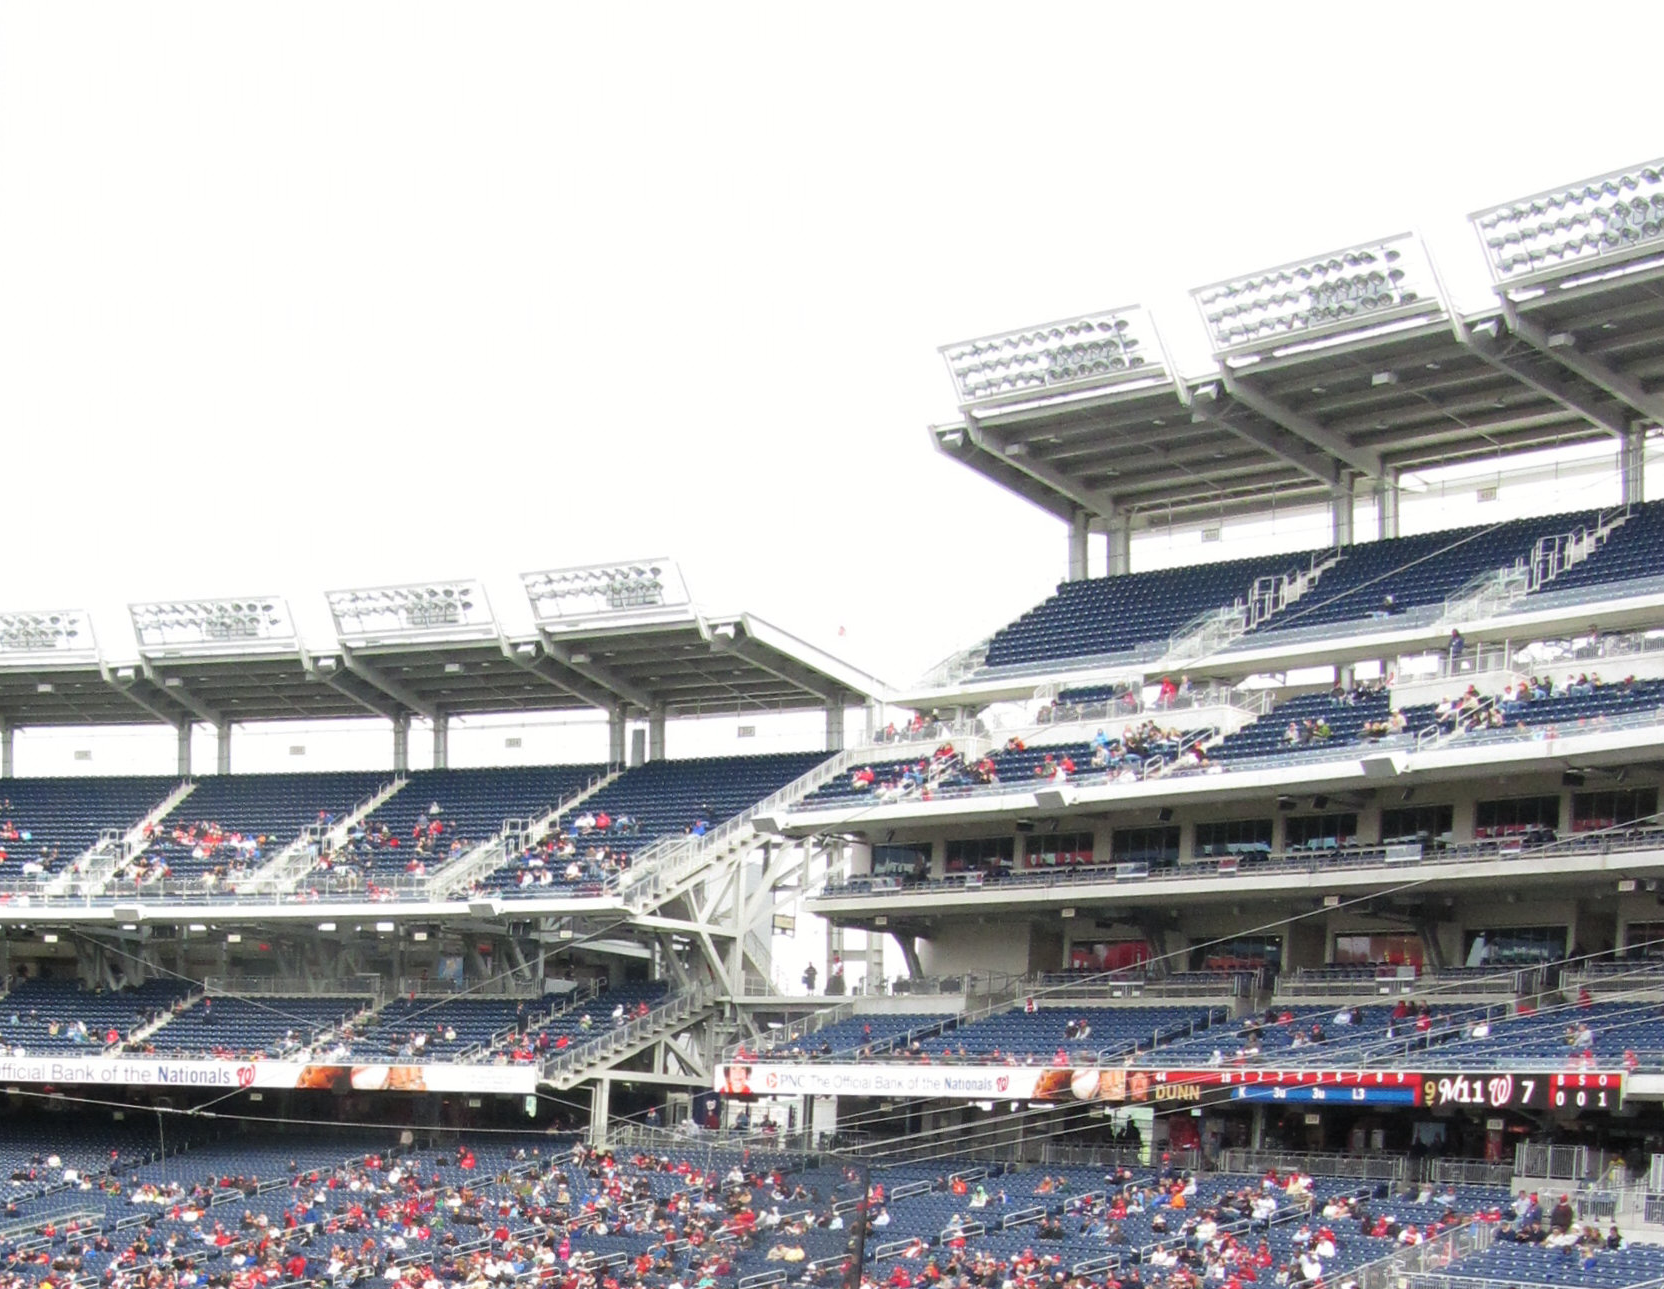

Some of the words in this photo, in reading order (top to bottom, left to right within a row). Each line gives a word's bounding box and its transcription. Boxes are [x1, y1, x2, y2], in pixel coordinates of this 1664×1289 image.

[52, 1064, 94, 1081] Bank
[101, 1065, 122, 1082] of
[129, 1065, 151, 1082] the
[158, 1066, 230, 1084] Nationals
[1462, 1080, 1484, 1103] 11
[1521, 1081, 1534, 1103] 7
